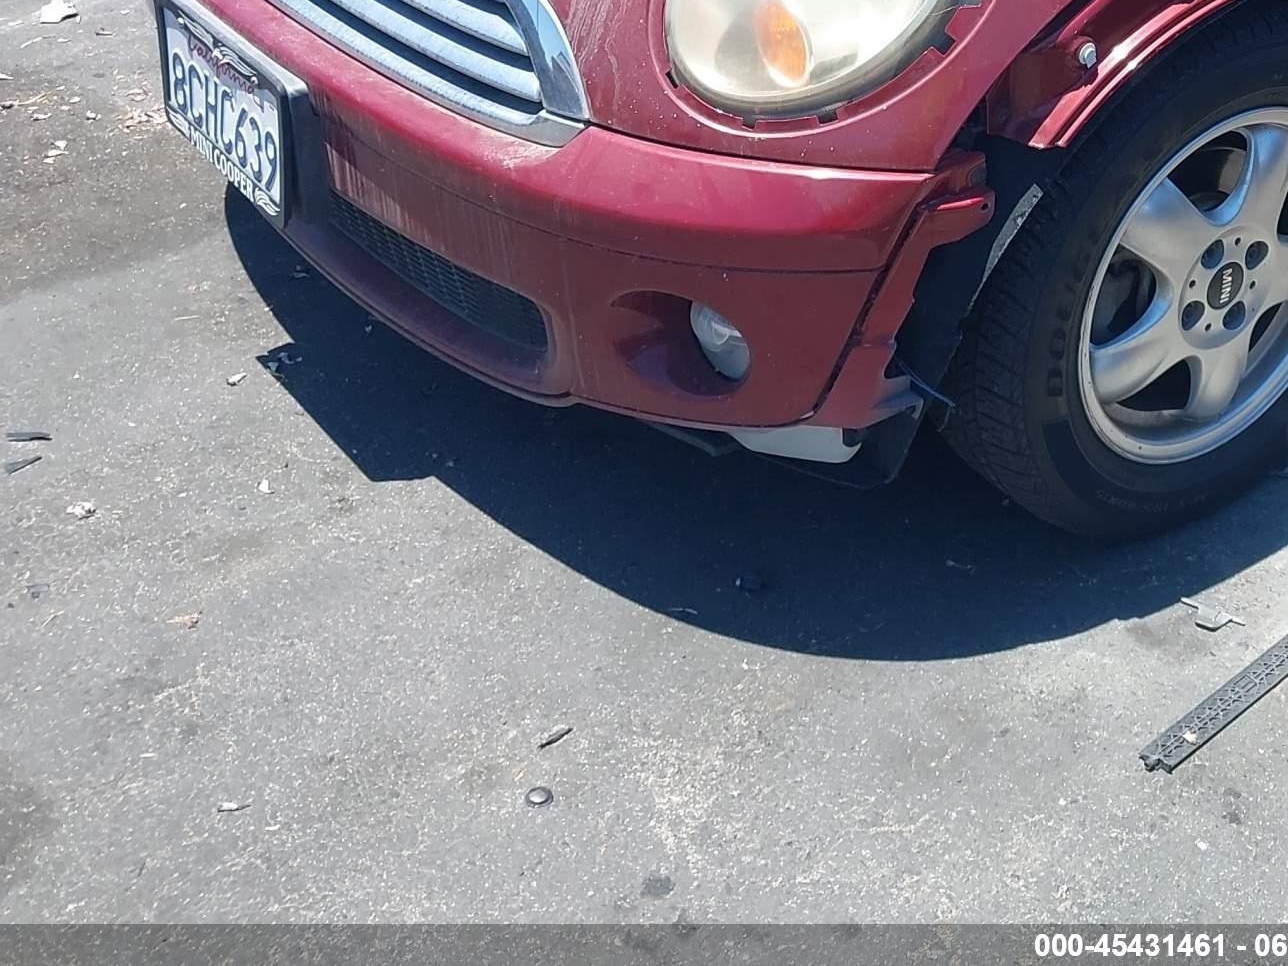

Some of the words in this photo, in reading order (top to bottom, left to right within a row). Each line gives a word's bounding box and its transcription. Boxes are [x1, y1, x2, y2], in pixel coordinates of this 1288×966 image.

[172, 51, 278, 193] 8CHC639
[190, 125, 215, 164] MINI
[213, 150, 257, 203] COOPER
[1219, 267, 1233, 304] MINI
